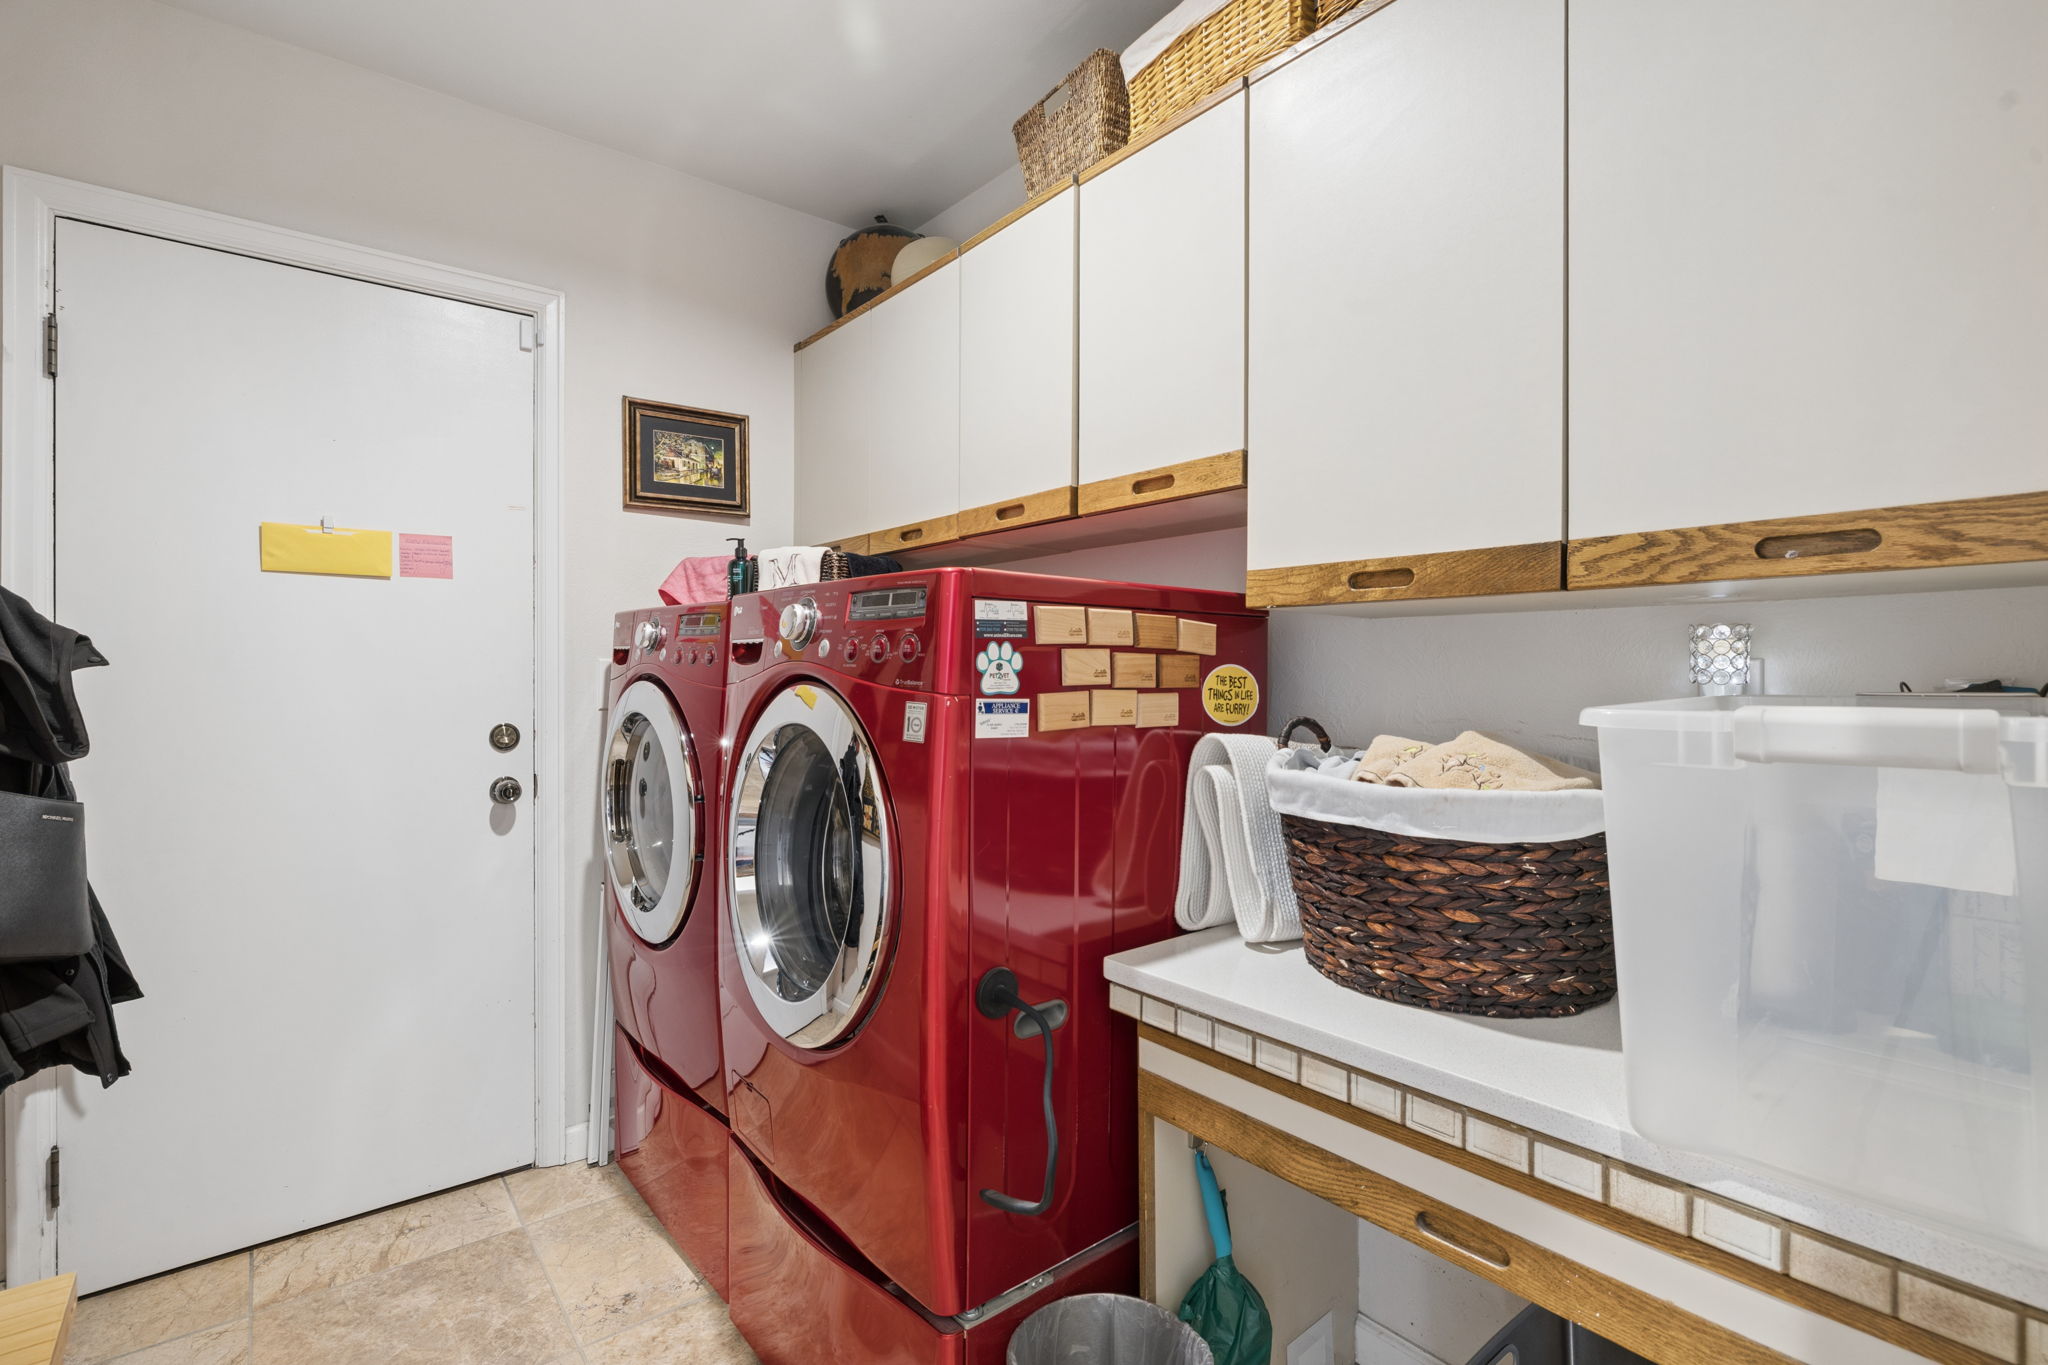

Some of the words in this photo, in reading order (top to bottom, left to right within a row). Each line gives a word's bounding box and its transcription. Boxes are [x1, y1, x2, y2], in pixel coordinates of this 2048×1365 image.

[1215, 674, 1228, 687] THE
[1228, 675, 1248, 689] BEST
[1207, 687, 1234, 702] THINGS
[1234, 689, 1240, 700] IN
[1240, 689, 1254, 701] LIFE
[1213, 702, 1225, 713] ARE
[1225, 702, 1251, 716] FURRY!
